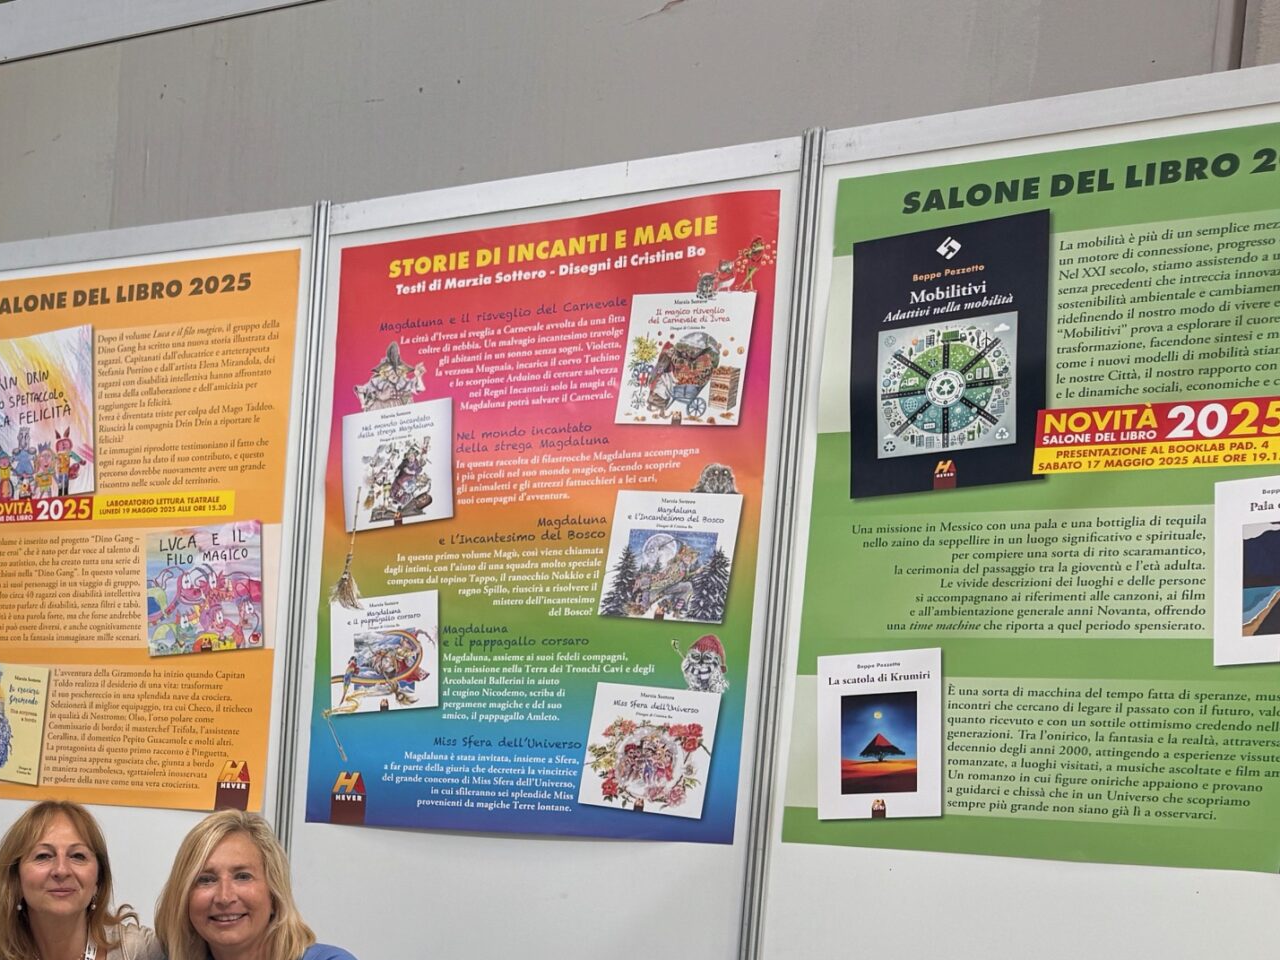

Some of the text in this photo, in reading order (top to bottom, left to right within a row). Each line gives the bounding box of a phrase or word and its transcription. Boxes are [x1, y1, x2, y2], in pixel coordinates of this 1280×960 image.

[902, 147, 1280, 215] SALONE DEL LIBRO 2
[388, 215, 718, 279] STORIE DI INCANTI E MAGIE
[395, 245, 706, 296] Testi di Marzia Sottero Disegni di Cristina Bo
[912, 263, 985, 282] Beppe Pezzetto
[72, 286, 111, 308] DEL
[115, 280, 183, 302] LIBRO
[189, 272, 252, 297] 2025
[910, 280, 987, 305] Mobilitivi
[882, 294, 1014, 324] Adattivi nella mobilità
[26, 370, 49, 386] DRIN
[19, 397, 71, 425] FELICITÀ
[1044, 400, 1280, 439] NOVITÀ 2025
[1042, 429, 1157, 445] SALONE DEL LIBRO
[1056, 441, 1270, 460] PRESENTAZIONE AL BOOKLAB PAD. 4
[1038, 452, 1280, 471] SABATO 17 MAGGIO 2025 ALLE ORE 19.1
[36, 498, 92, 521] 2025
[99, 505, 120, 515] LUNEDÌ
[122, 506, 130, 514] 19
[131, 505, 159, 513] MAGGIO
[160, 505, 176, 513] 2025
[208, 504, 227, 512] 15.30
[106, 495, 220, 507] LABORATORIO LETTURA TEATRALE
[16, 514, 33, 522] LIBRO
[159, 530, 246, 552] LUCA E IL
[166, 548, 249, 566] FILO MAGICO
[828, 671, 931, 686] La scatola di Krumiri
[220, 782, 247, 790] HEVER
